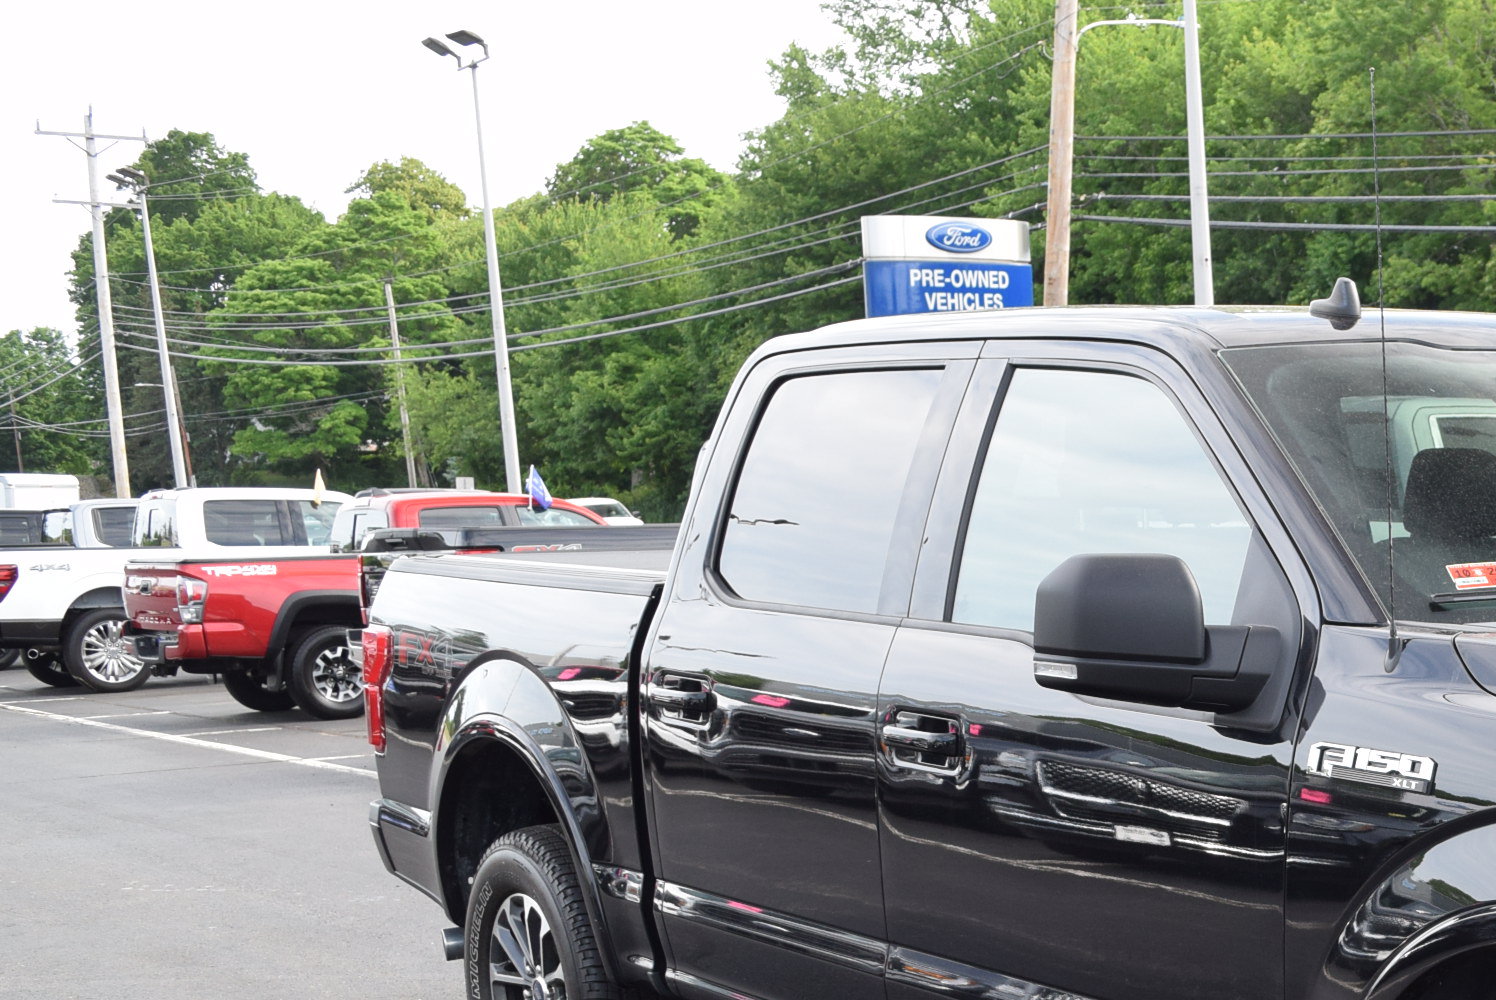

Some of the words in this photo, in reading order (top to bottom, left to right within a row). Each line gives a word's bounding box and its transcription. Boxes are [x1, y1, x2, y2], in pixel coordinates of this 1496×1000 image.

[943, 226, 982, 247] Ford
[909, 269, 1010, 290] PRE-OWNED
[924, 291, 1004, 312] VEHICLES
[201, 565, 242, 577] TRD
[1455, 568, 1472, 579] 10
[398, 628, 454, 673] FX4
[1391, 777, 1420, 790] XLT
[469, 880, 494, 1000] MICHELIN
